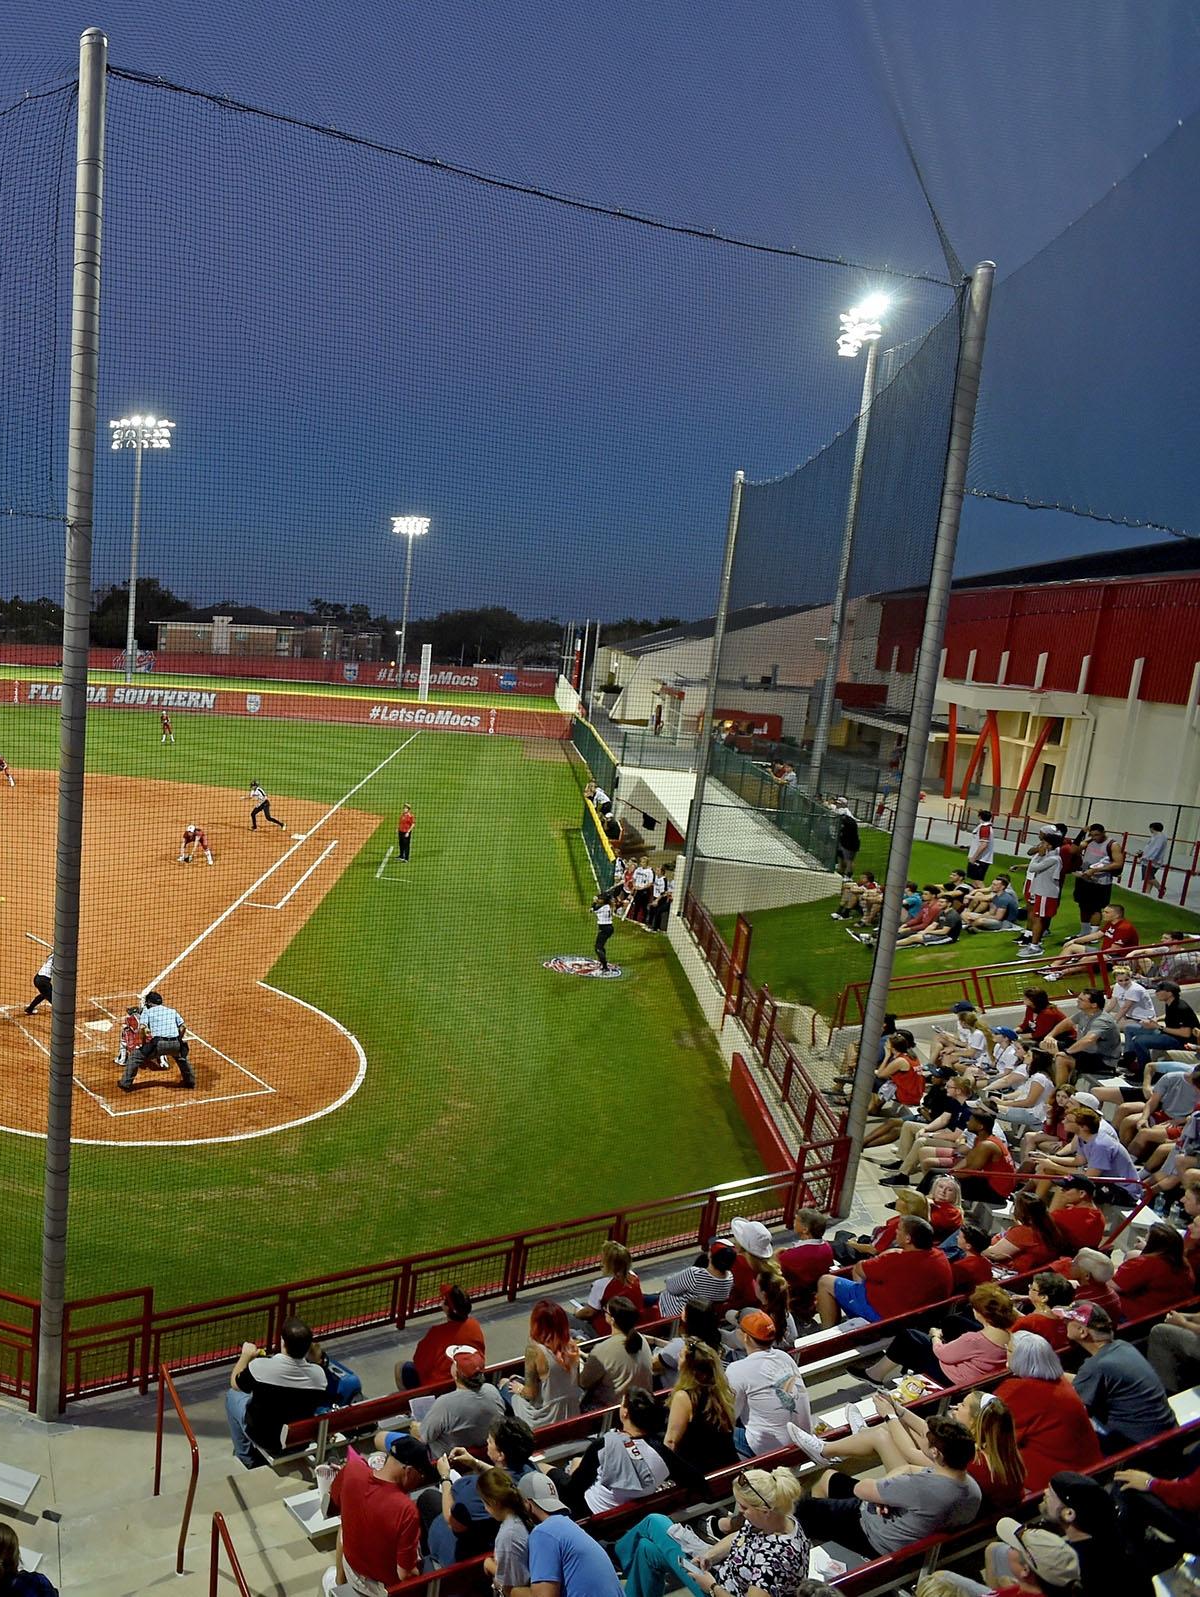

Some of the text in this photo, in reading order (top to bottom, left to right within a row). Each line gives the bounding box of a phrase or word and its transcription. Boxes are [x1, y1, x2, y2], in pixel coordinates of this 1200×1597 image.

[28, 684, 217, 709] FLODA SOUTHERN
[369, 705, 481, 727] #LetsGoMocs
